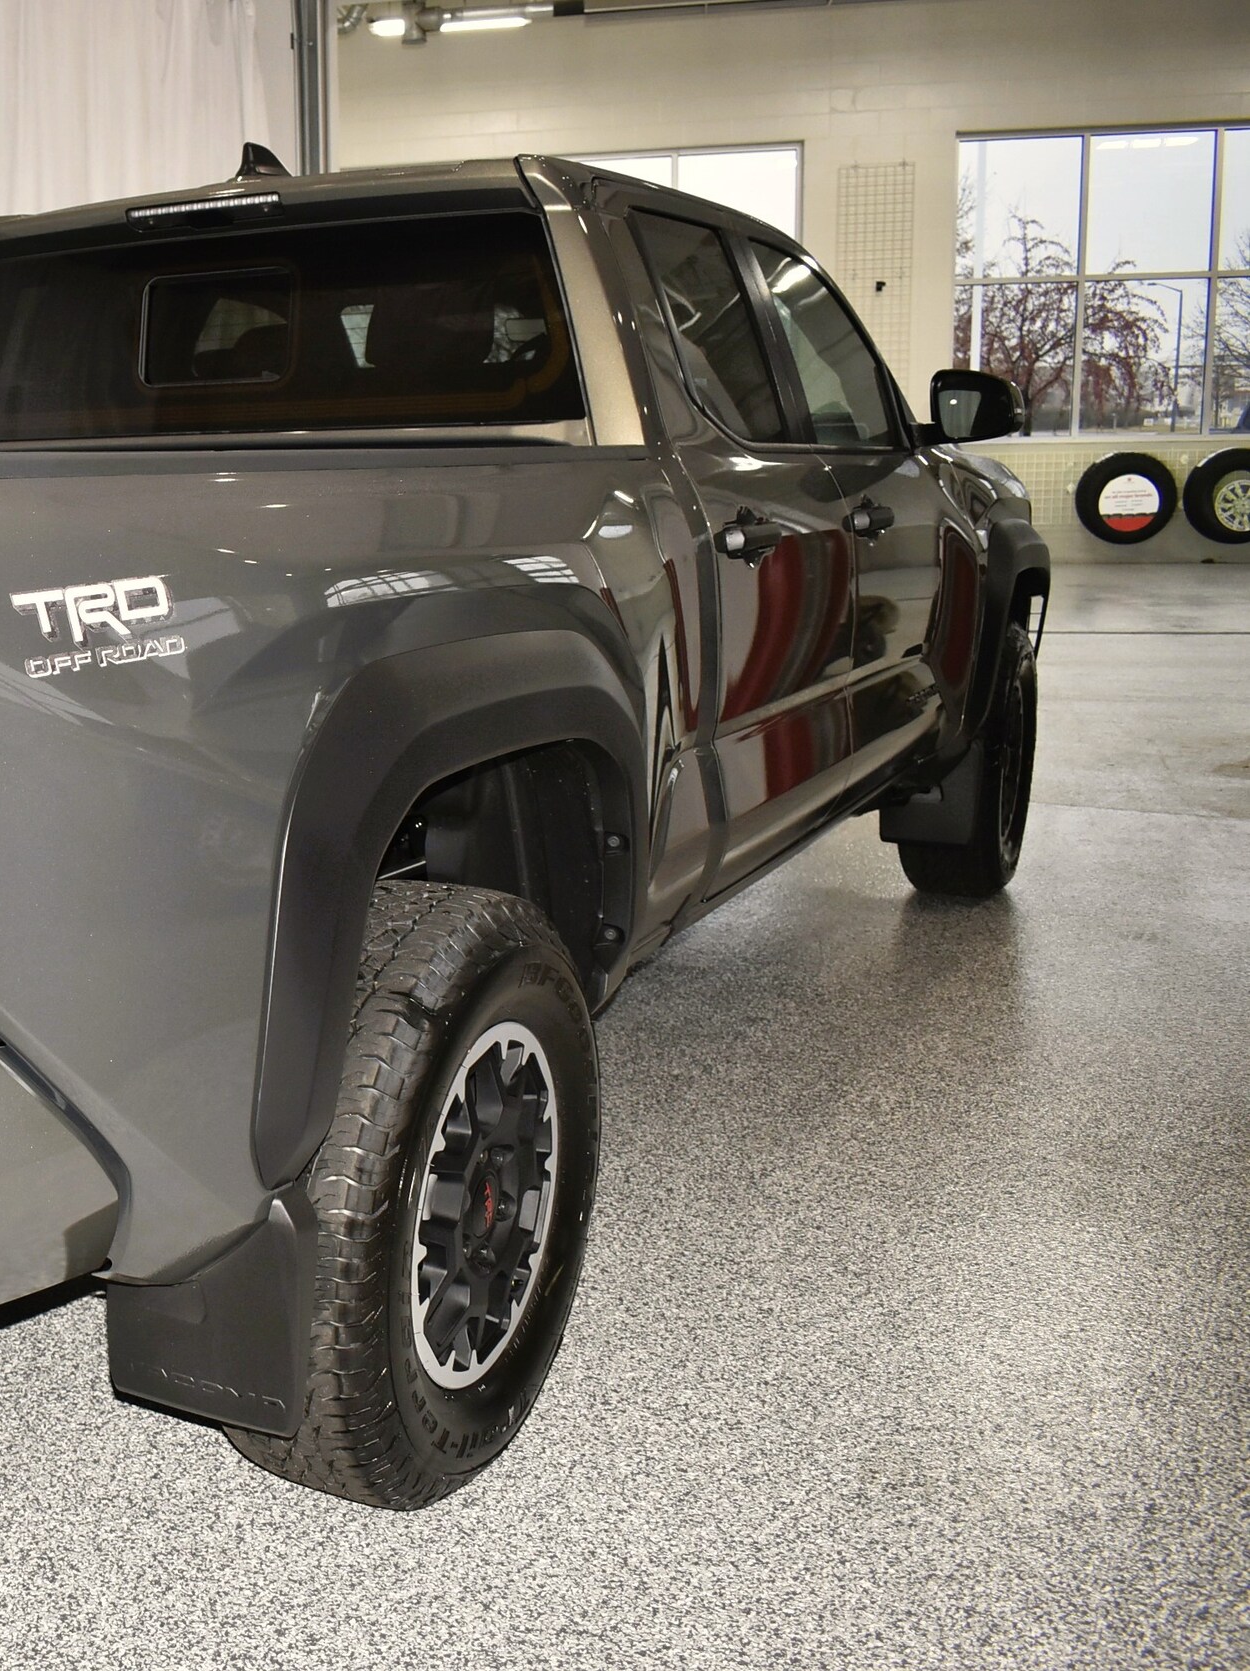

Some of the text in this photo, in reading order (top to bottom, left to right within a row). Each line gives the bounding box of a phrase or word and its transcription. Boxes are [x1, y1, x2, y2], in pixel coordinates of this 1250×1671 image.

[9, 575, 173, 645] TRD
[24, 635, 187, 679] OFF ROAD
